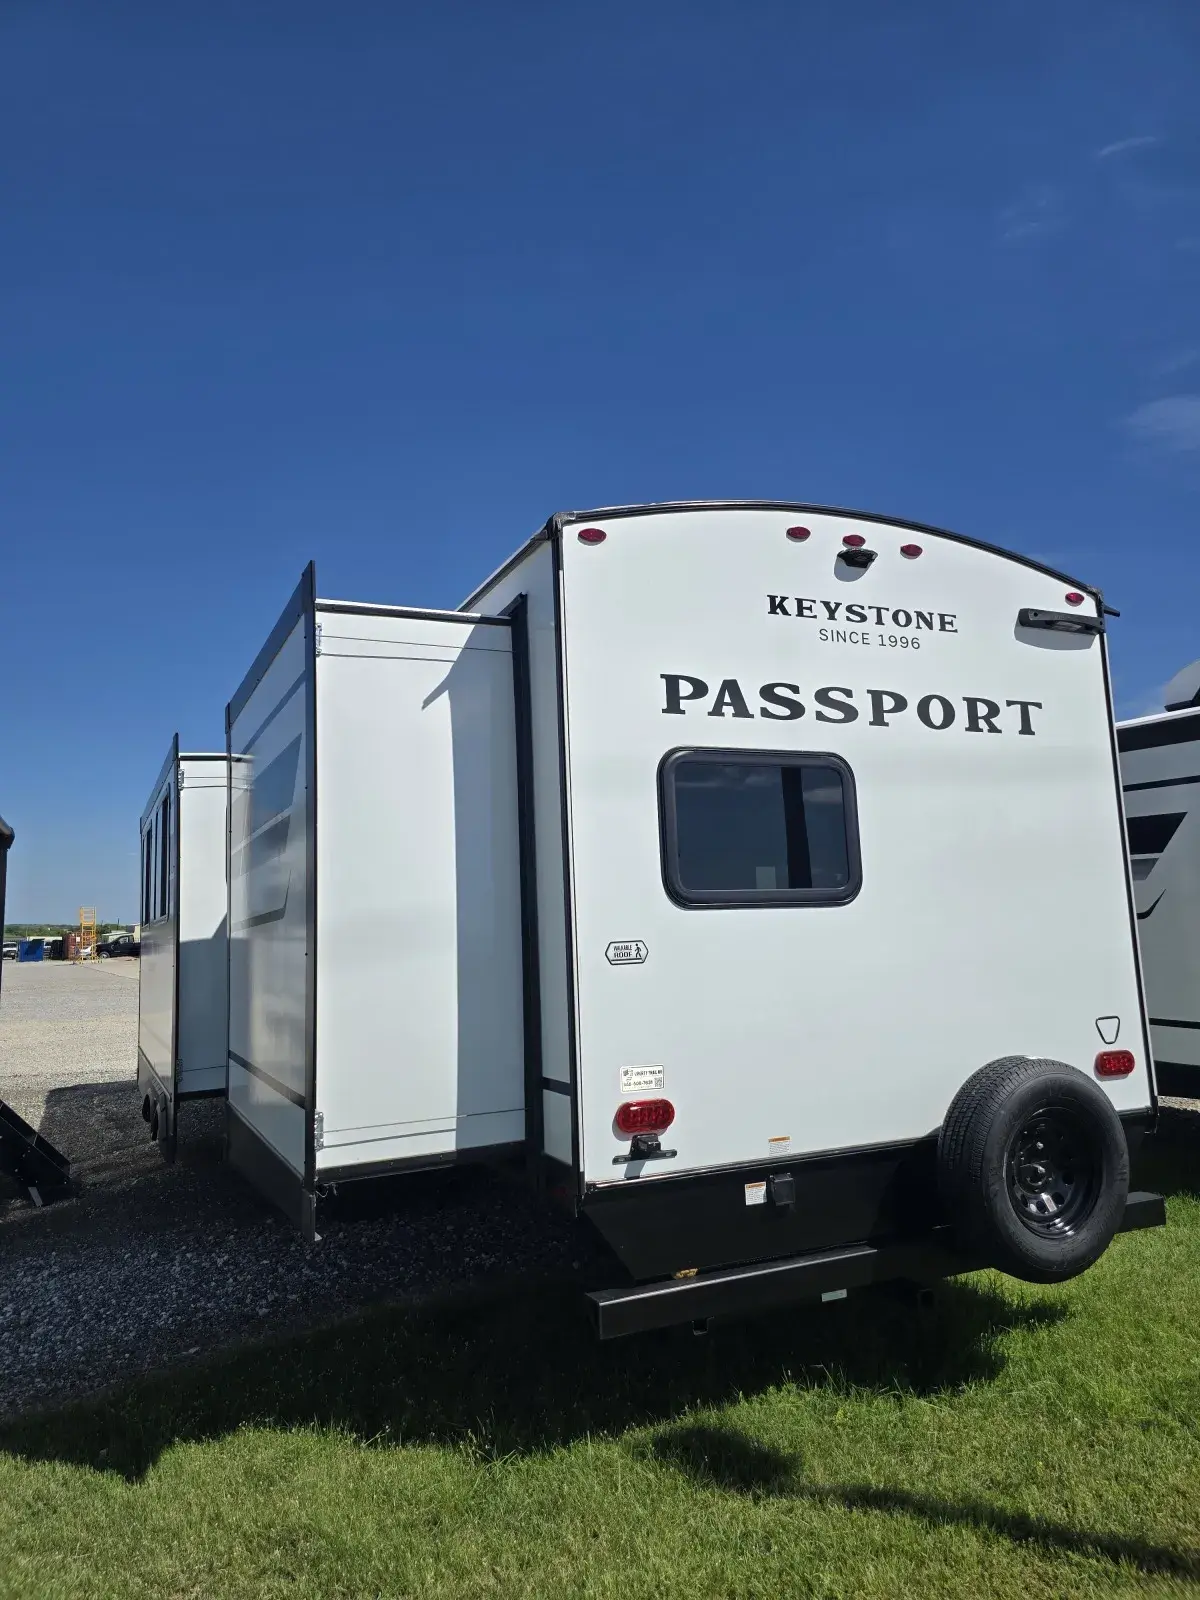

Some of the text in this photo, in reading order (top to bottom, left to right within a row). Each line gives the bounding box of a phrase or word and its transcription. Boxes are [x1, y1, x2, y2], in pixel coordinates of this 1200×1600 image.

[767, 594, 958, 633] KEYSTONE
[819, 628, 921, 650] SINCE 1996
[659, 673, 1043, 736] PASSPORT
